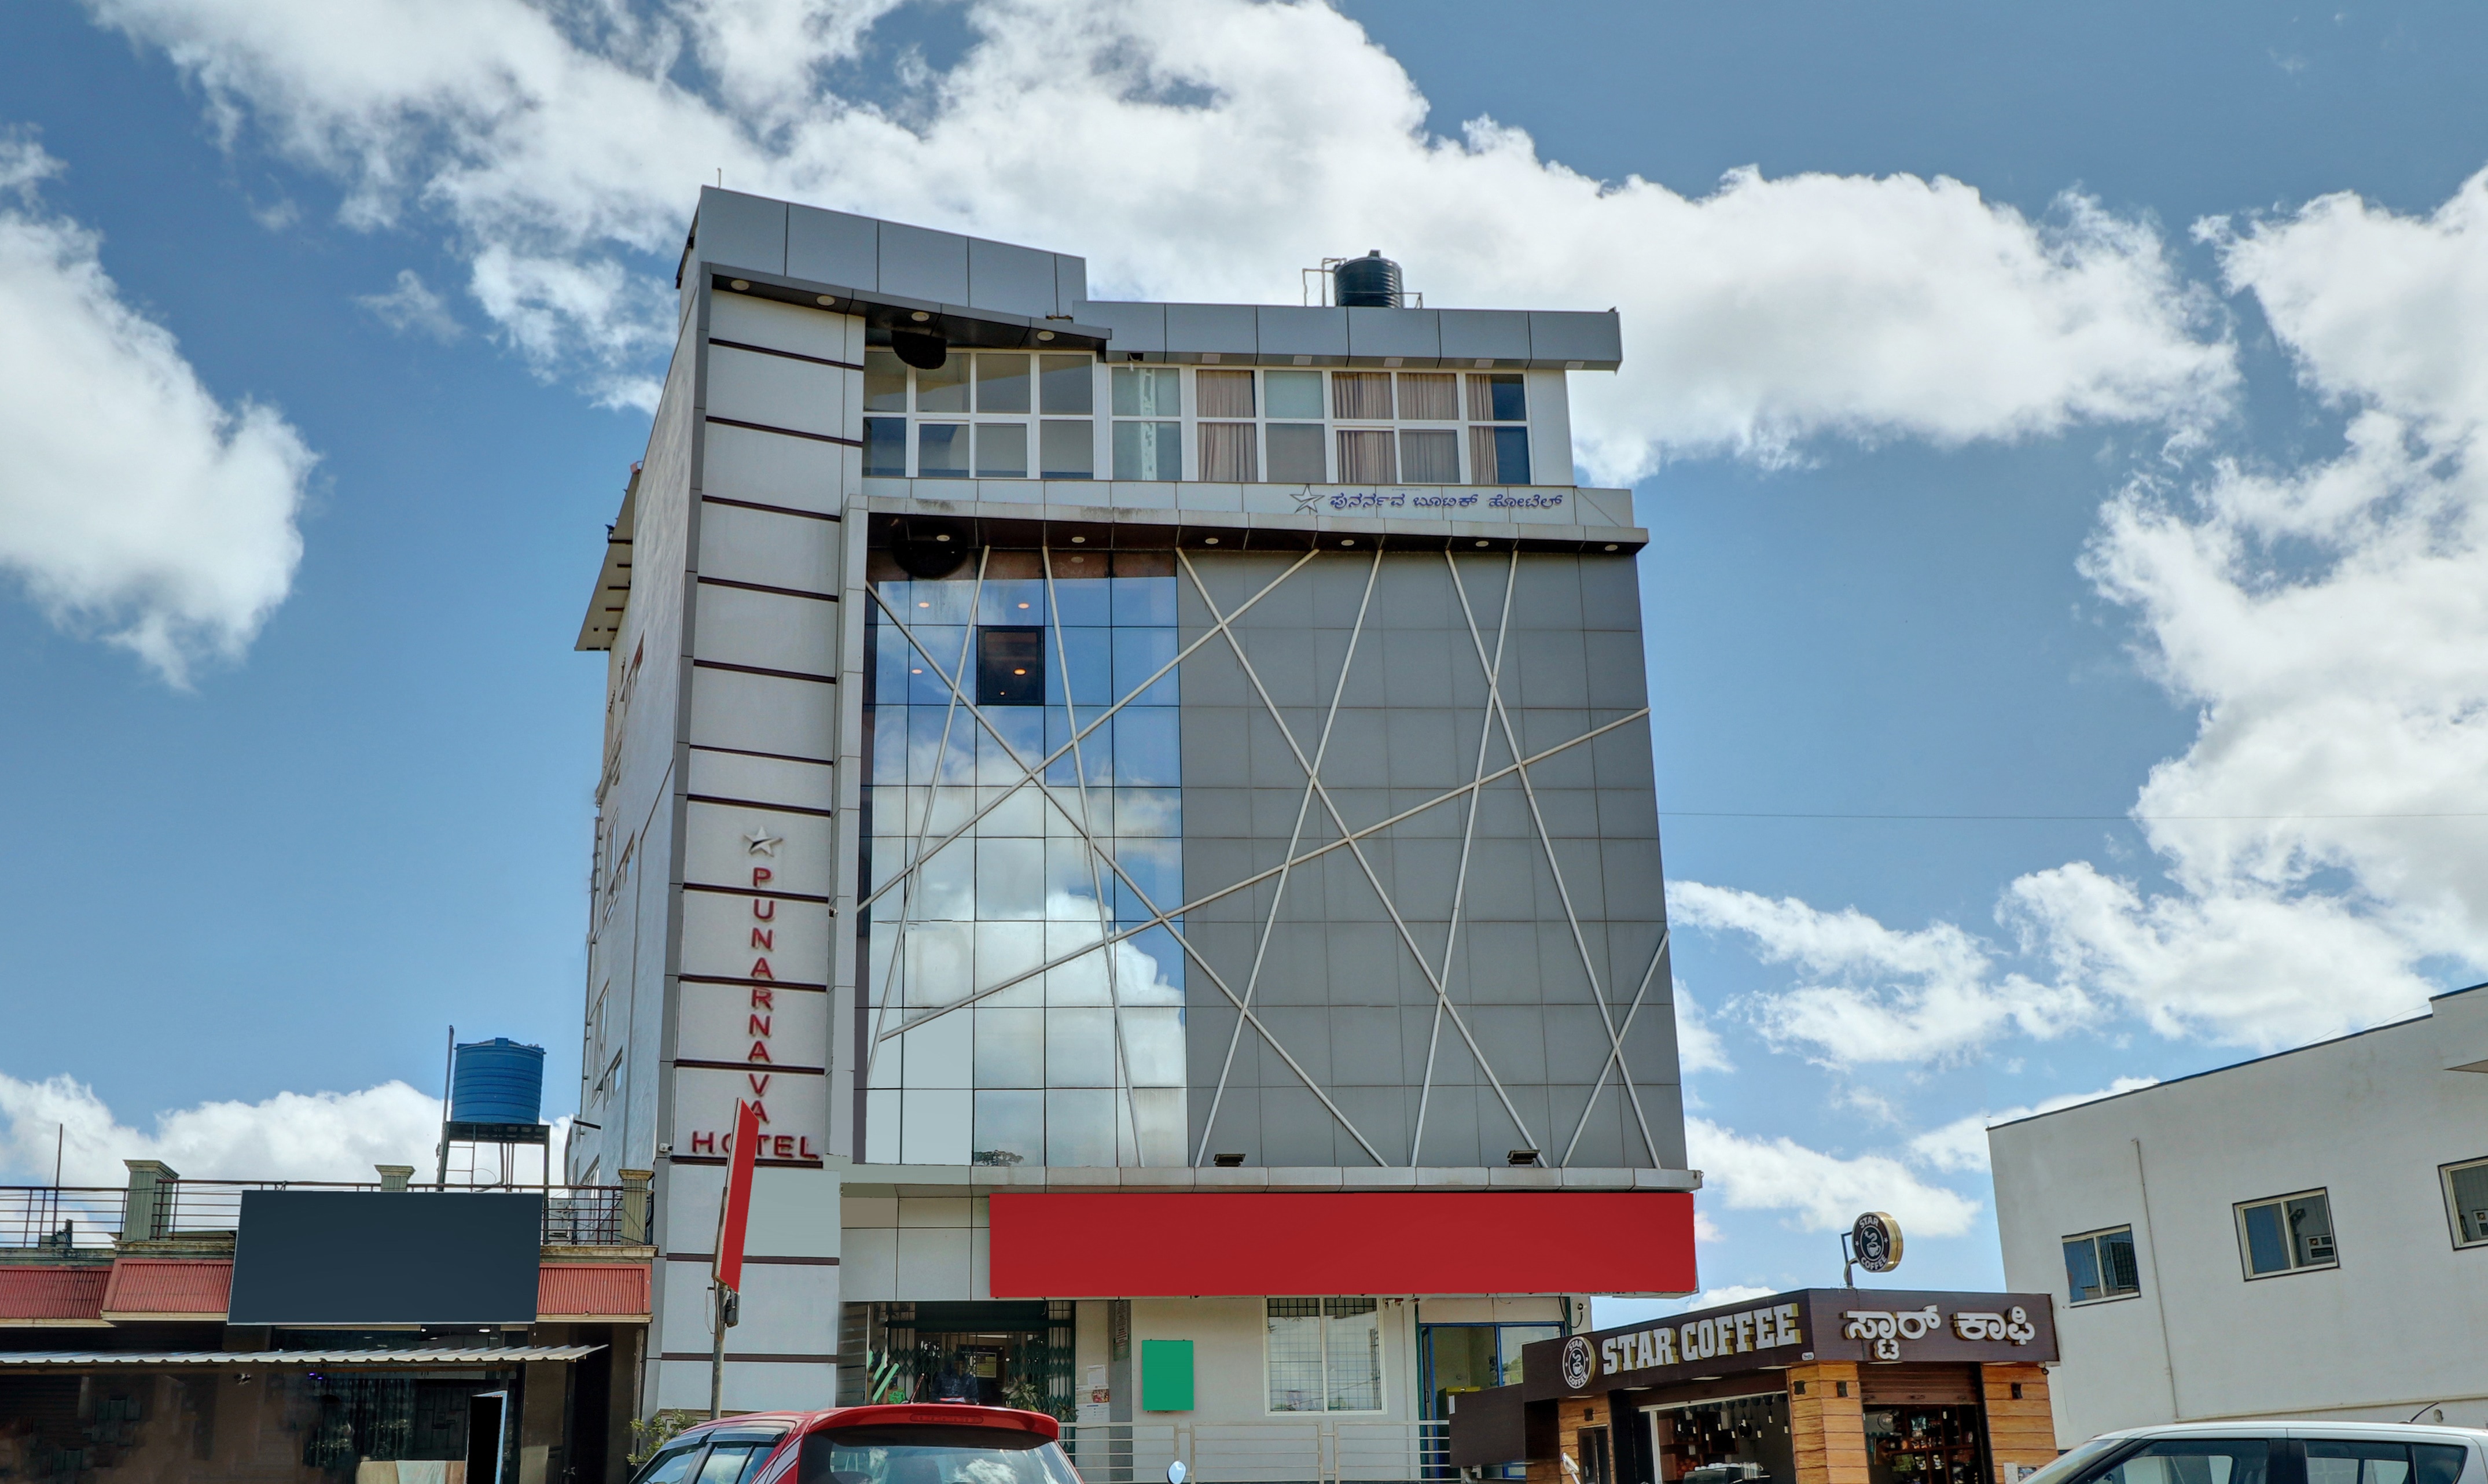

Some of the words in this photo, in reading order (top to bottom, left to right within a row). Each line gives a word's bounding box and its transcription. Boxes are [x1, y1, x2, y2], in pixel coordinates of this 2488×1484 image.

[1329, 492, 1405, 510] ಪುನರ್ನವ
[1413, 494, 1479, 507] ಬೂಟಿಕ್
[1487, 494, 1563, 509] ಹೋಟೆಲ್
[748, 867, 774, 1124] PUNARNAVA
[1859, 1216, 1879, 1229] STAR
[1861, 1254, 1887, 1270] COFFEE
[1602, 1327, 1678, 1375] STAR
[1681, 1303, 1801, 1361] COFFEE
[1844, 1304, 1942, 1360] ಸ್ಟಾರ್
[1954, 1305, 2035, 1346] ಕಾಫಿ
[1568, 1340, 1583, 1352] STAR
[1568, 1372, 1587, 1386] COFFEE
